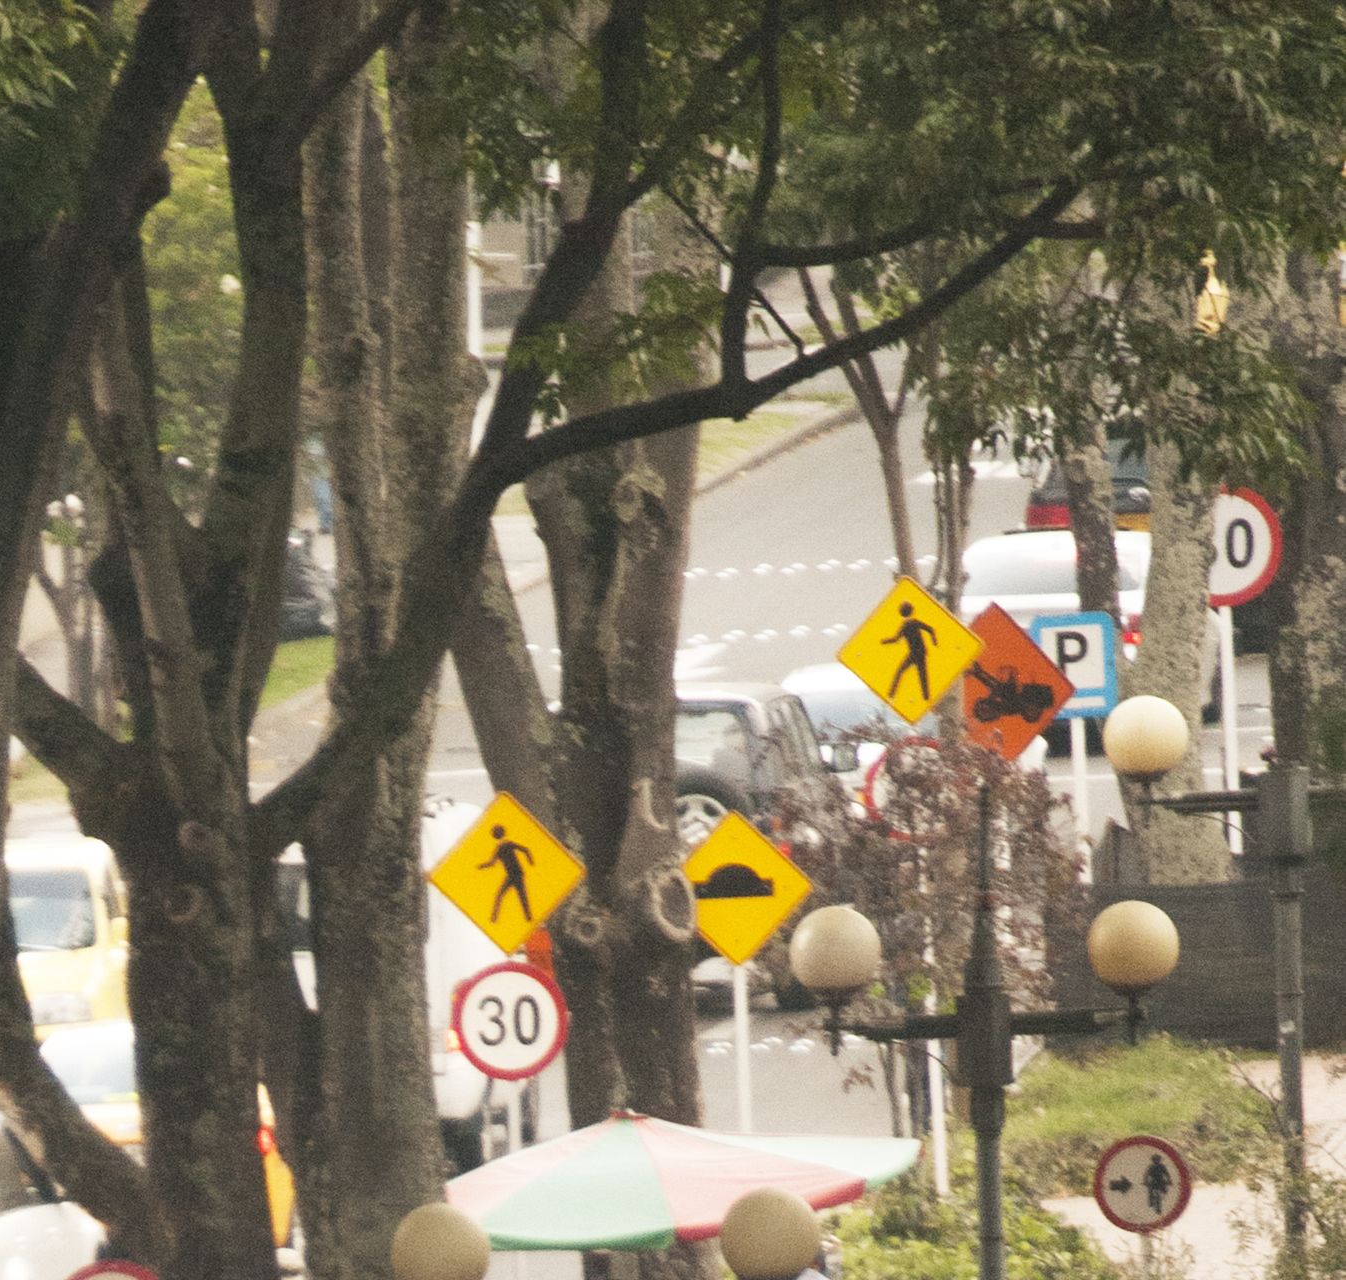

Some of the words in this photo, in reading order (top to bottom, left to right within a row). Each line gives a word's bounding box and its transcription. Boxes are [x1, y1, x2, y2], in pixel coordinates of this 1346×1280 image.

[1226, 518, 1254, 568] 0
[1057, 631, 1088, 674] P
[478, 995, 540, 1046] 30
